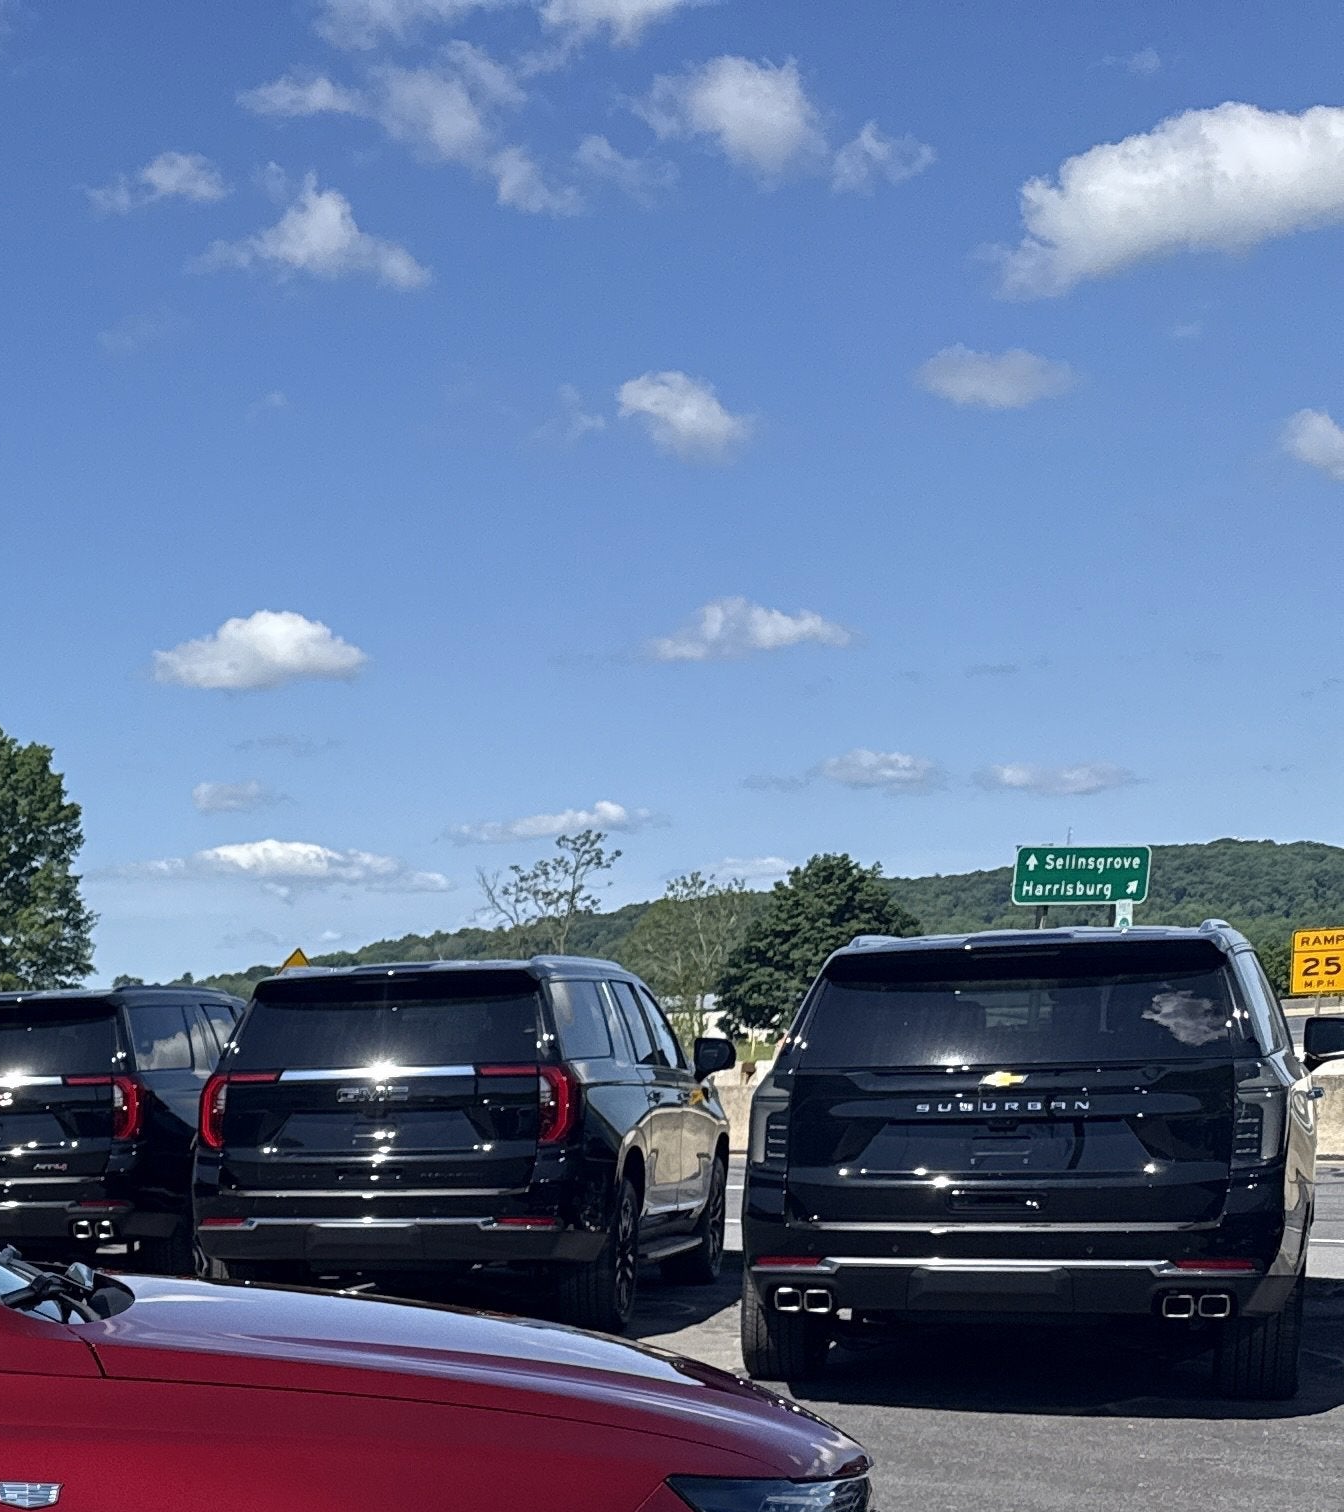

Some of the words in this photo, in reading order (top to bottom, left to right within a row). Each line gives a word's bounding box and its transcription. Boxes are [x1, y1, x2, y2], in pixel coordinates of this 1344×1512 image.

[1044, 854, 1141, 874] Selinsgrove
[1021, 880, 1112, 900] Harrisburg
[1300, 934, 1344, 947] RAMP
[1302, 956, 1342, 976] 25
[336, 1086, 409, 1102] GMC
[916, 1101, 1090, 1113] SUBURBAN
